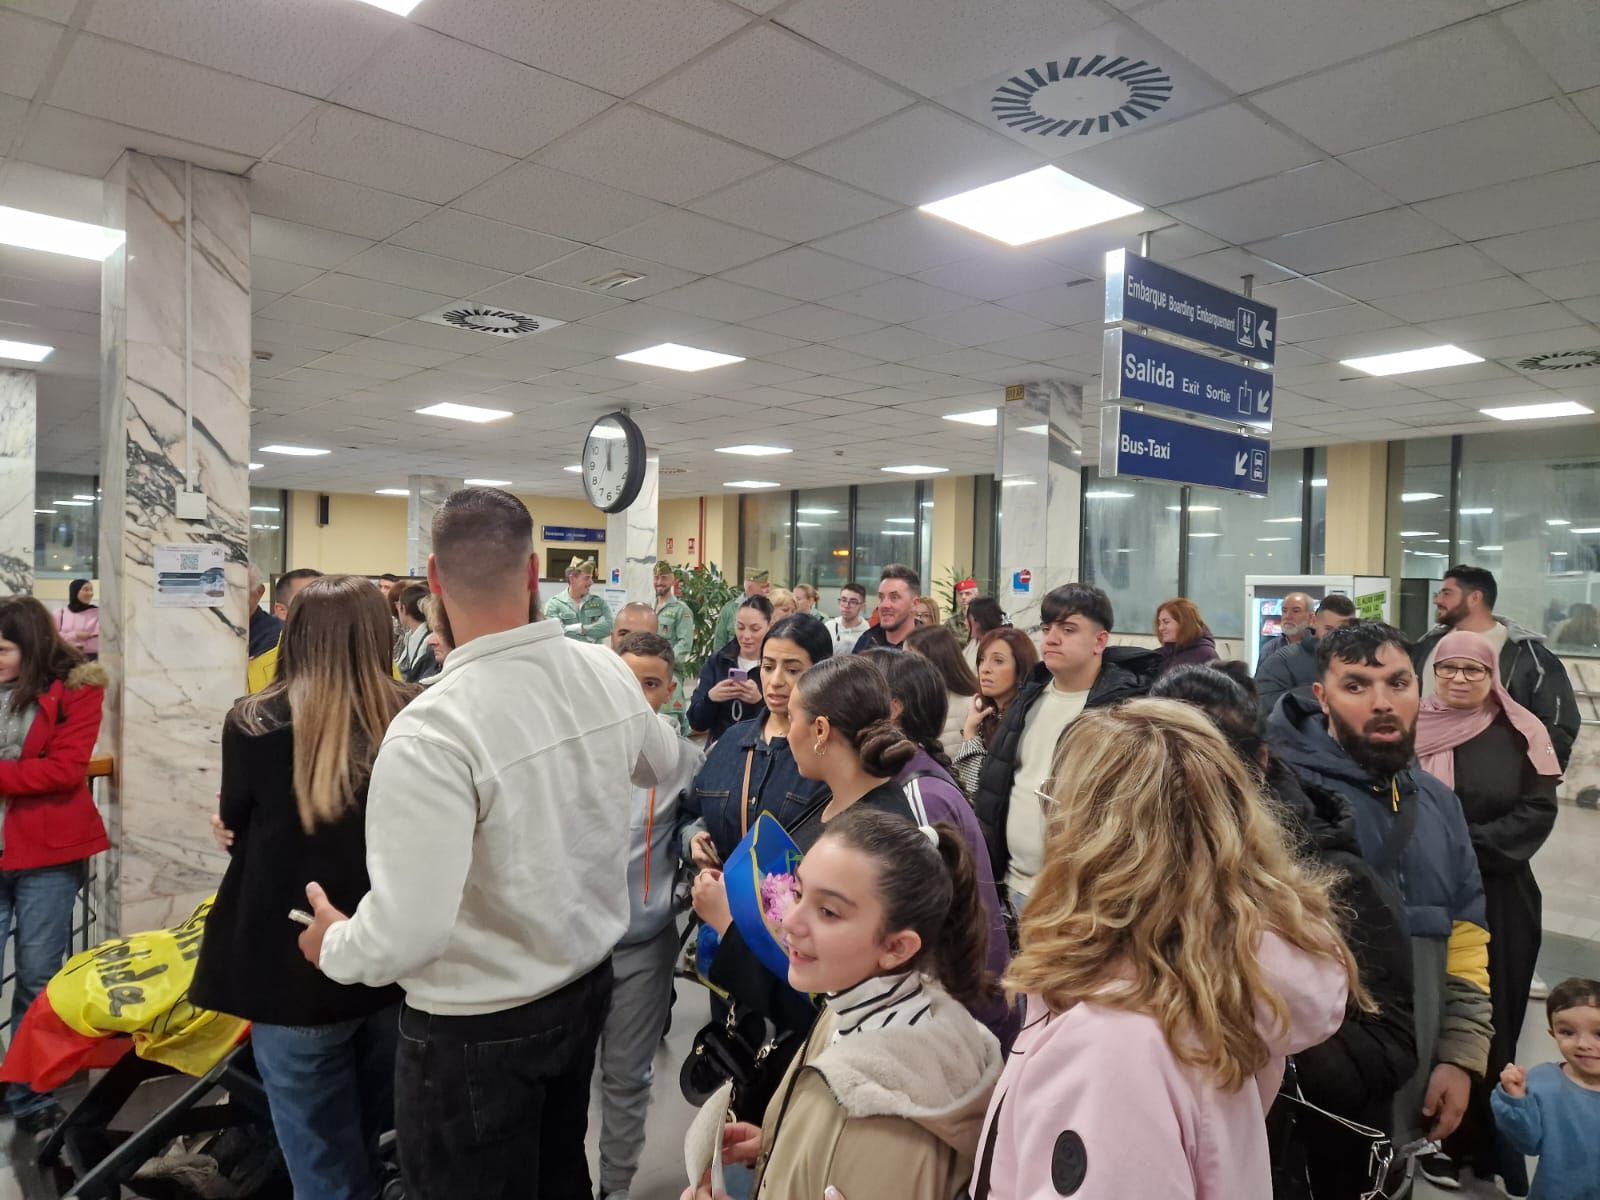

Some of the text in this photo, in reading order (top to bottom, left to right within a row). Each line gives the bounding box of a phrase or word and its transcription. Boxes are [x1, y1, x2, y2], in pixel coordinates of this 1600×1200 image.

[1127, 275, 1236, 332] Embarque Boarding Embarquement
[1125, 352, 1231, 403] Salida Exit Sortie
[592, 446, 599, 455] 10
[1121, 433, 1171, 460] Bus-Taxi
[590, 461, 595, 471] 9
[592, 476, 598, 485] 8
[599, 487, 604, 496] 7
[616, 485, 622, 495] 5
[606, 492, 612, 501] 6
